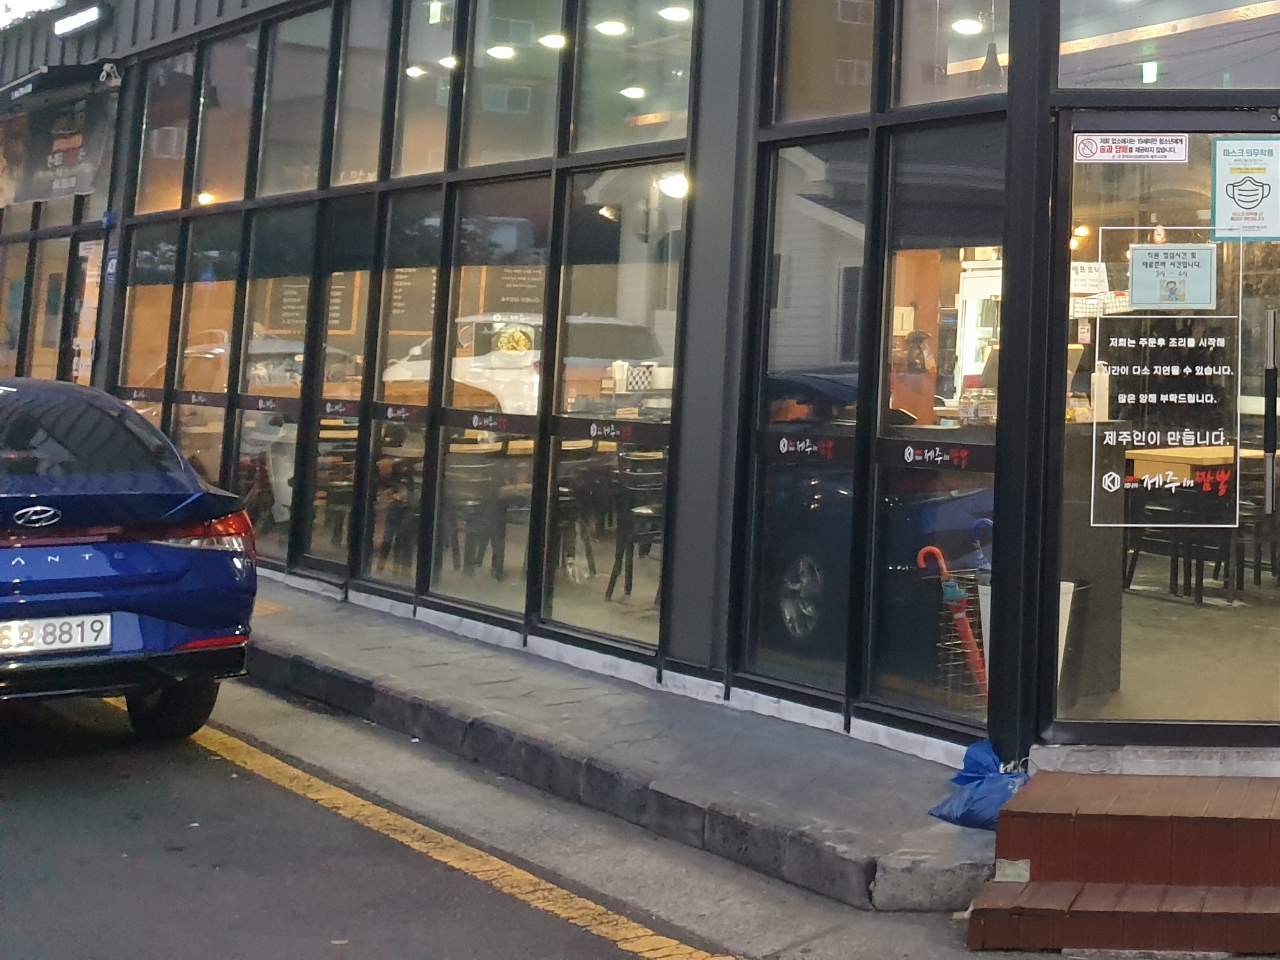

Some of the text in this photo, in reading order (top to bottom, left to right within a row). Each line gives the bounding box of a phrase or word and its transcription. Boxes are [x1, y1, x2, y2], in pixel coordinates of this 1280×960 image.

[1223, 149, 1244, 157] 마스크
[1132, 366, 1150, 376] 다소
[1183, 366, 1192, 376] 수
[1103, 429, 1230, 446] 제주인이 만듭니다.
